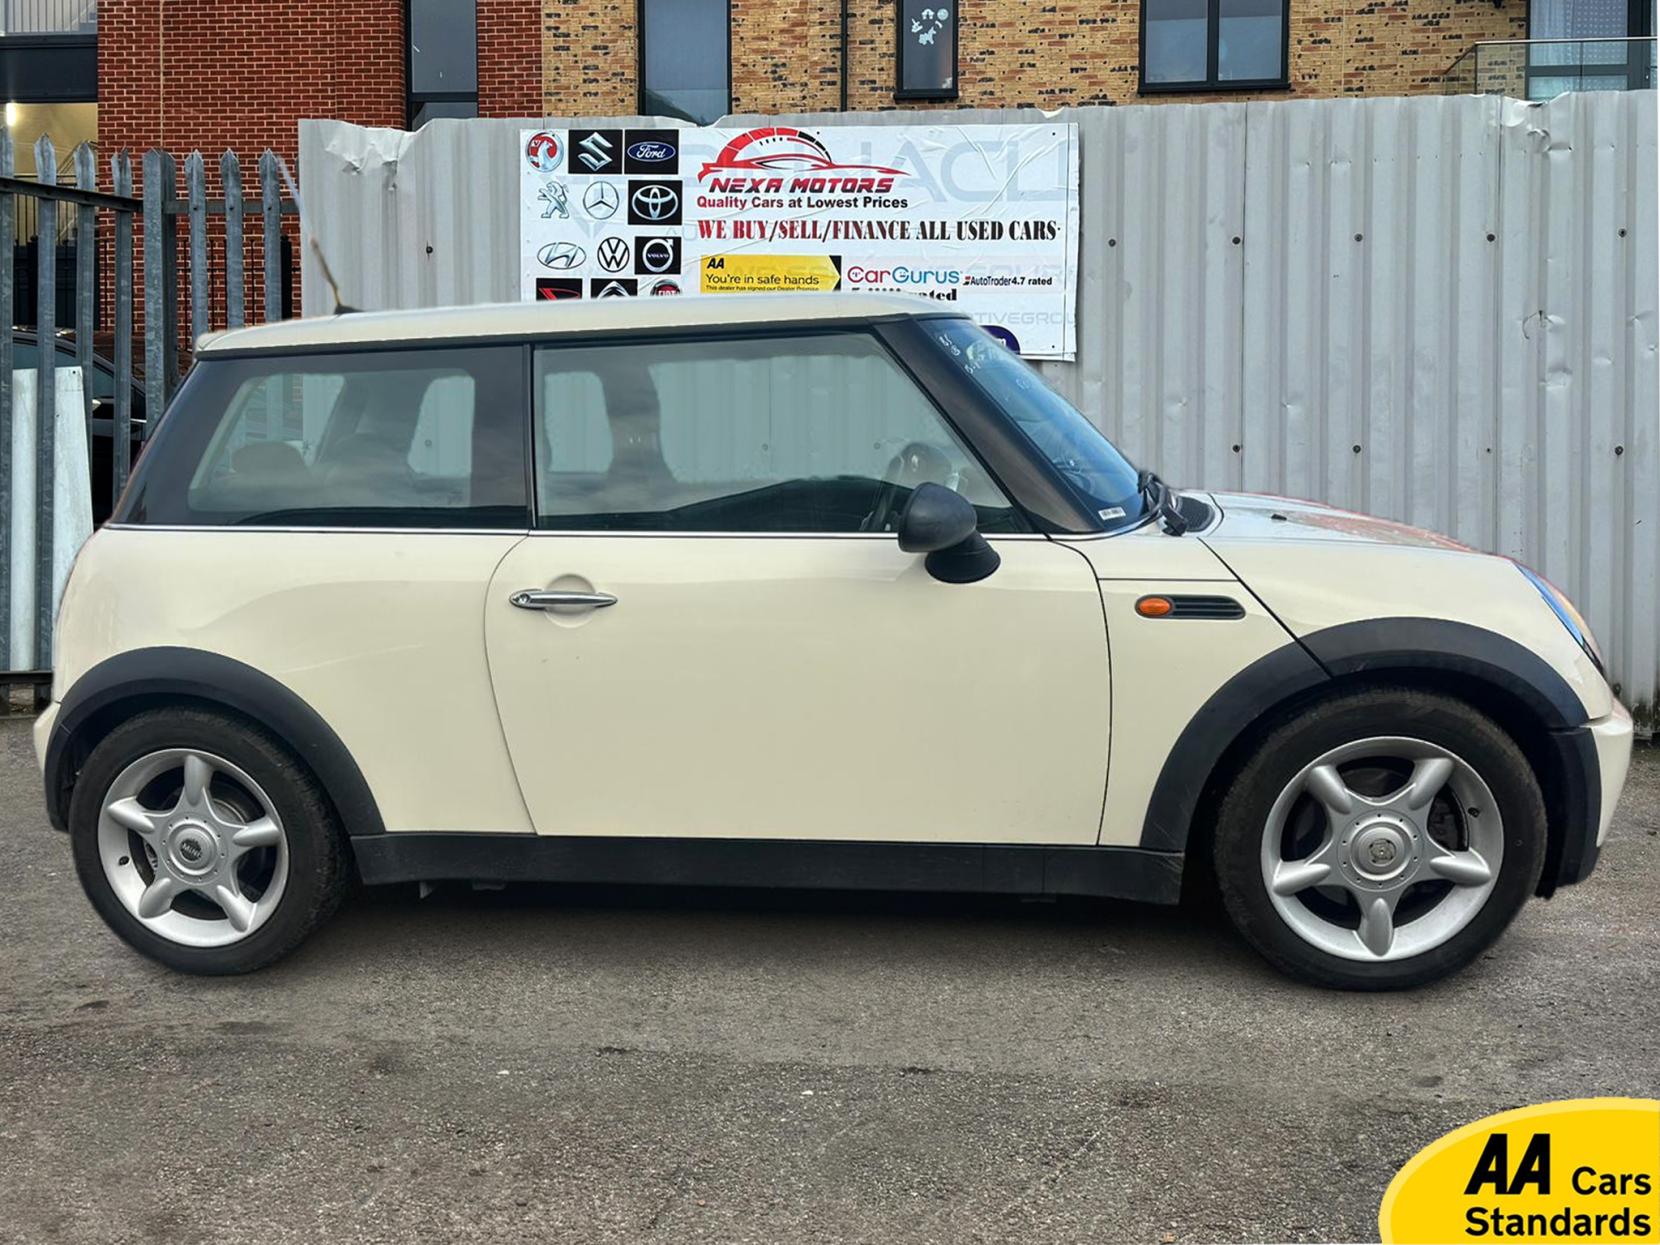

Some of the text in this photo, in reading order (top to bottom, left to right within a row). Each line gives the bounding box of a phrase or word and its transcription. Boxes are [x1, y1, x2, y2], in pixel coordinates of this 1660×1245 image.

[636, 144, 667, 159] Ford
[708, 177, 895, 193] NEXA MOTORS
[697, 196, 909, 210] Quality Cars at Lowest Prices
[697, 220, 727, 240] WE
[916, 220, 951, 240] ALL
[956, 220, 1004, 240] USED
[1008, 220, 1057, 240] CARS
[706, 257, 725, 269] AA
[706, 273, 820, 285] You're in safe hands
[847, 266, 960, 284] CarGurus
[1028, 277, 1053, 286] rated
